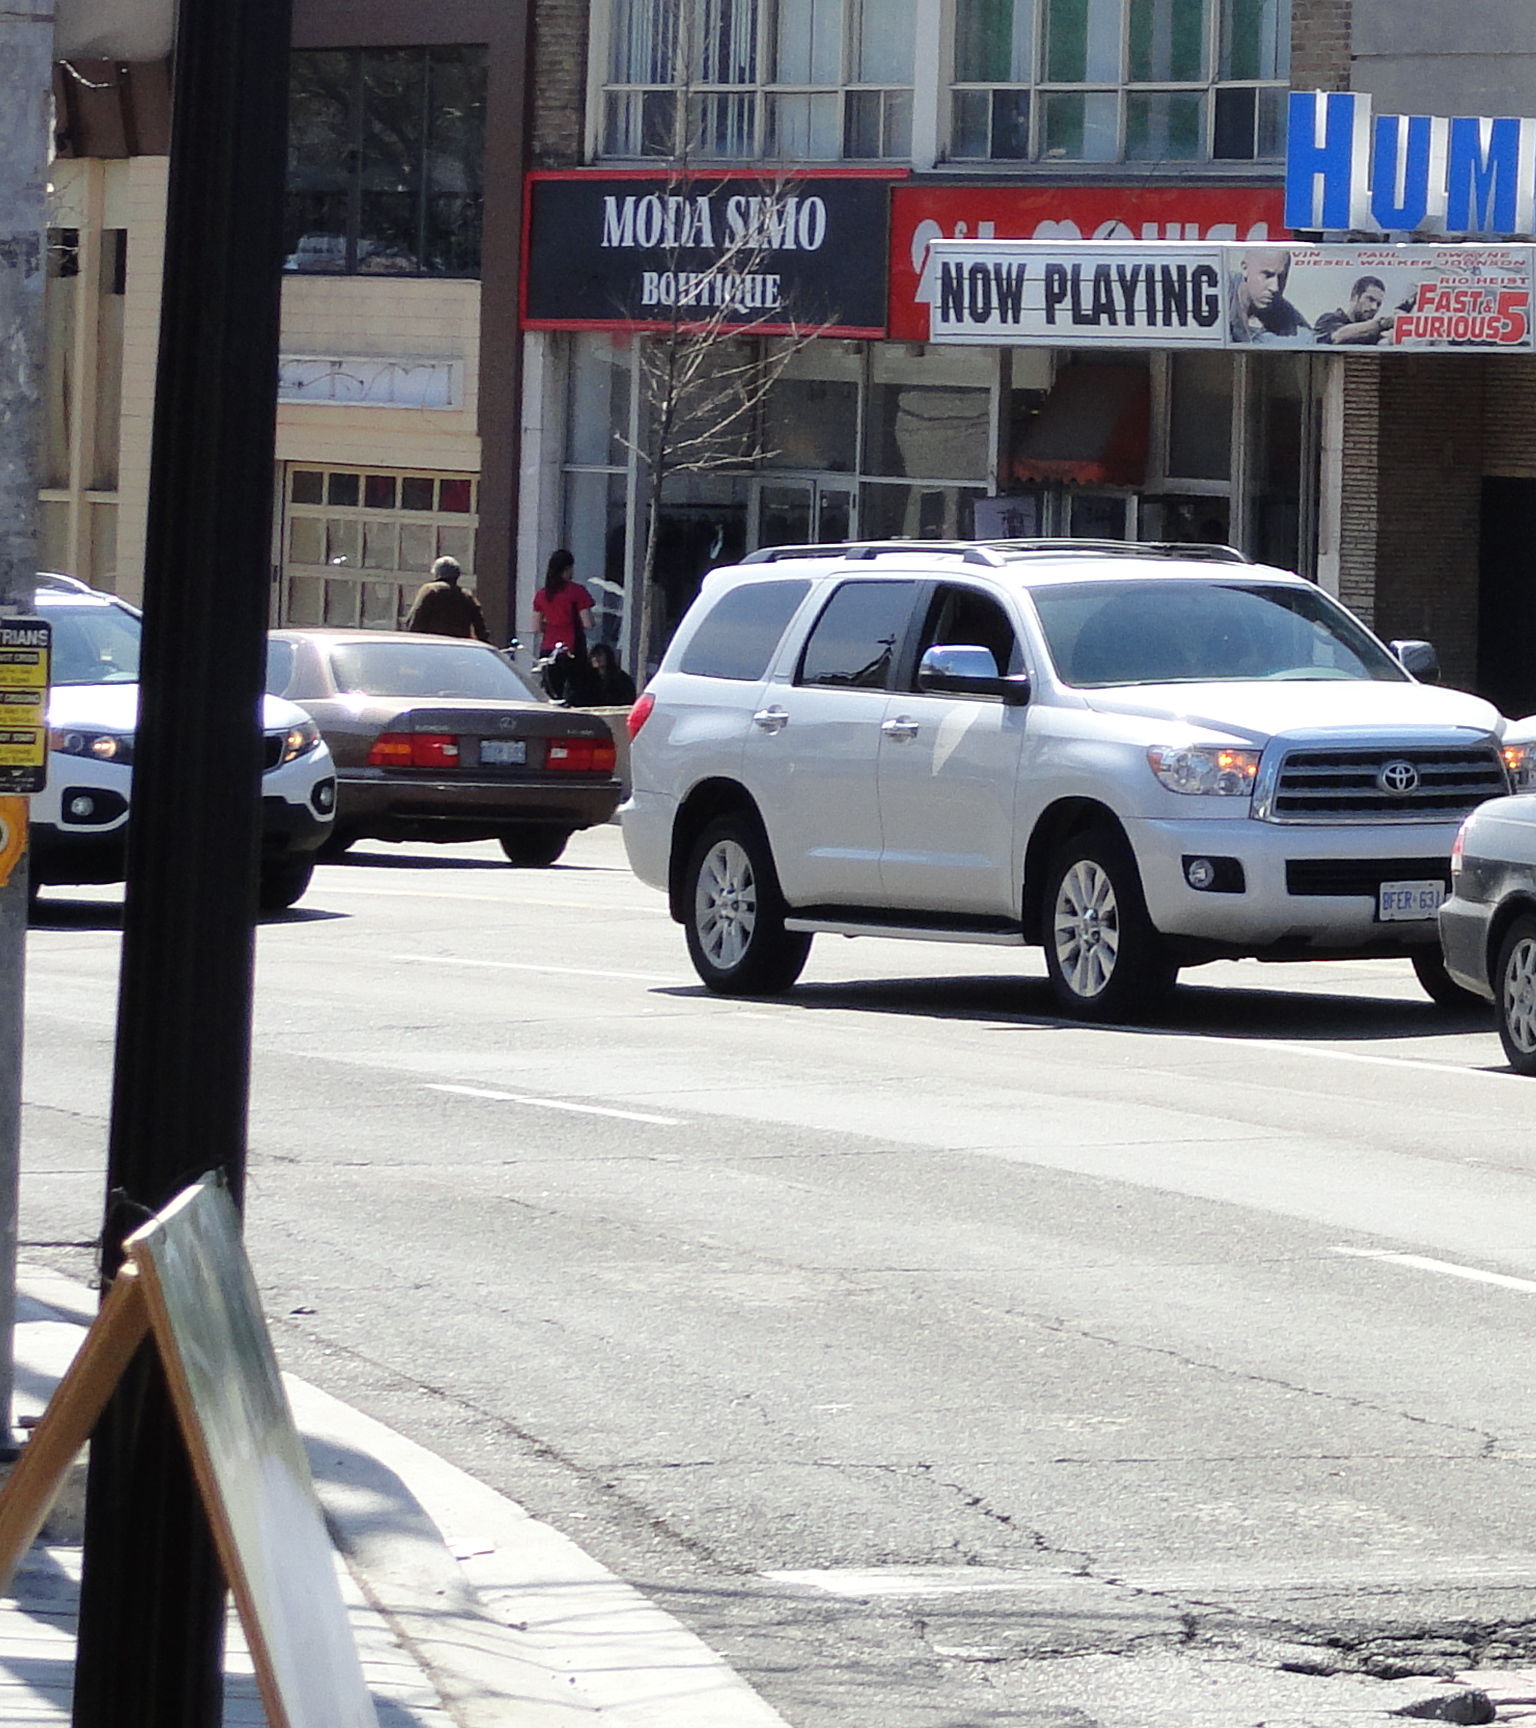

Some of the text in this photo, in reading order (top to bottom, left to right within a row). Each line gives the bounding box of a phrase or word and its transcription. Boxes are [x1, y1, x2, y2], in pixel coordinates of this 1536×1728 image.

[600, 194, 715, 249] MODA
[1292, 250, 1512, 260] VIN PAUL DWAYNE
[1293, 259, 1528, 267] DIESEL WALKER JOHNSON
[940, 260, 1220, 329] NOW PLAYING
[1438, 276, 1531, 286] RIO HEIST
[1416, 283, 1494, 314] FAST &
[1393, 290, 1531, 346] FURIOUS 5
